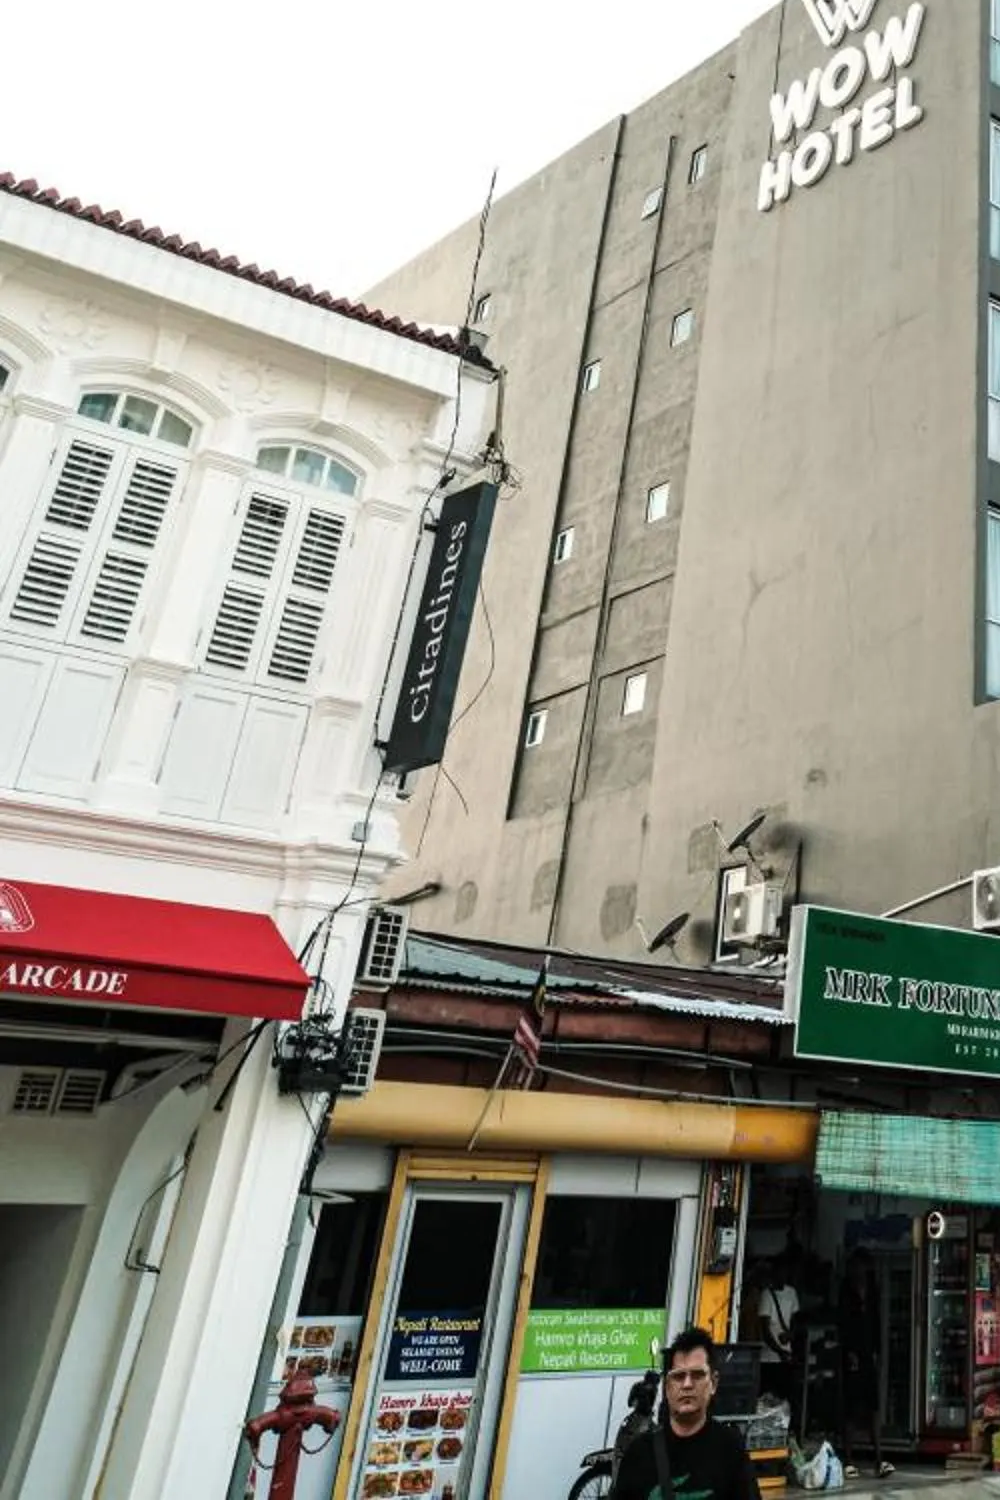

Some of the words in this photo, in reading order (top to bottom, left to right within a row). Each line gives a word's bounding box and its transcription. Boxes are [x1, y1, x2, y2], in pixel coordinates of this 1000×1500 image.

[769, 2, 925, 143] WOW
[757, 77, 924, 212] HOTEL
[0, 963, 128, 995] ARCADE
[824, 966, 892, 1008] MRK
